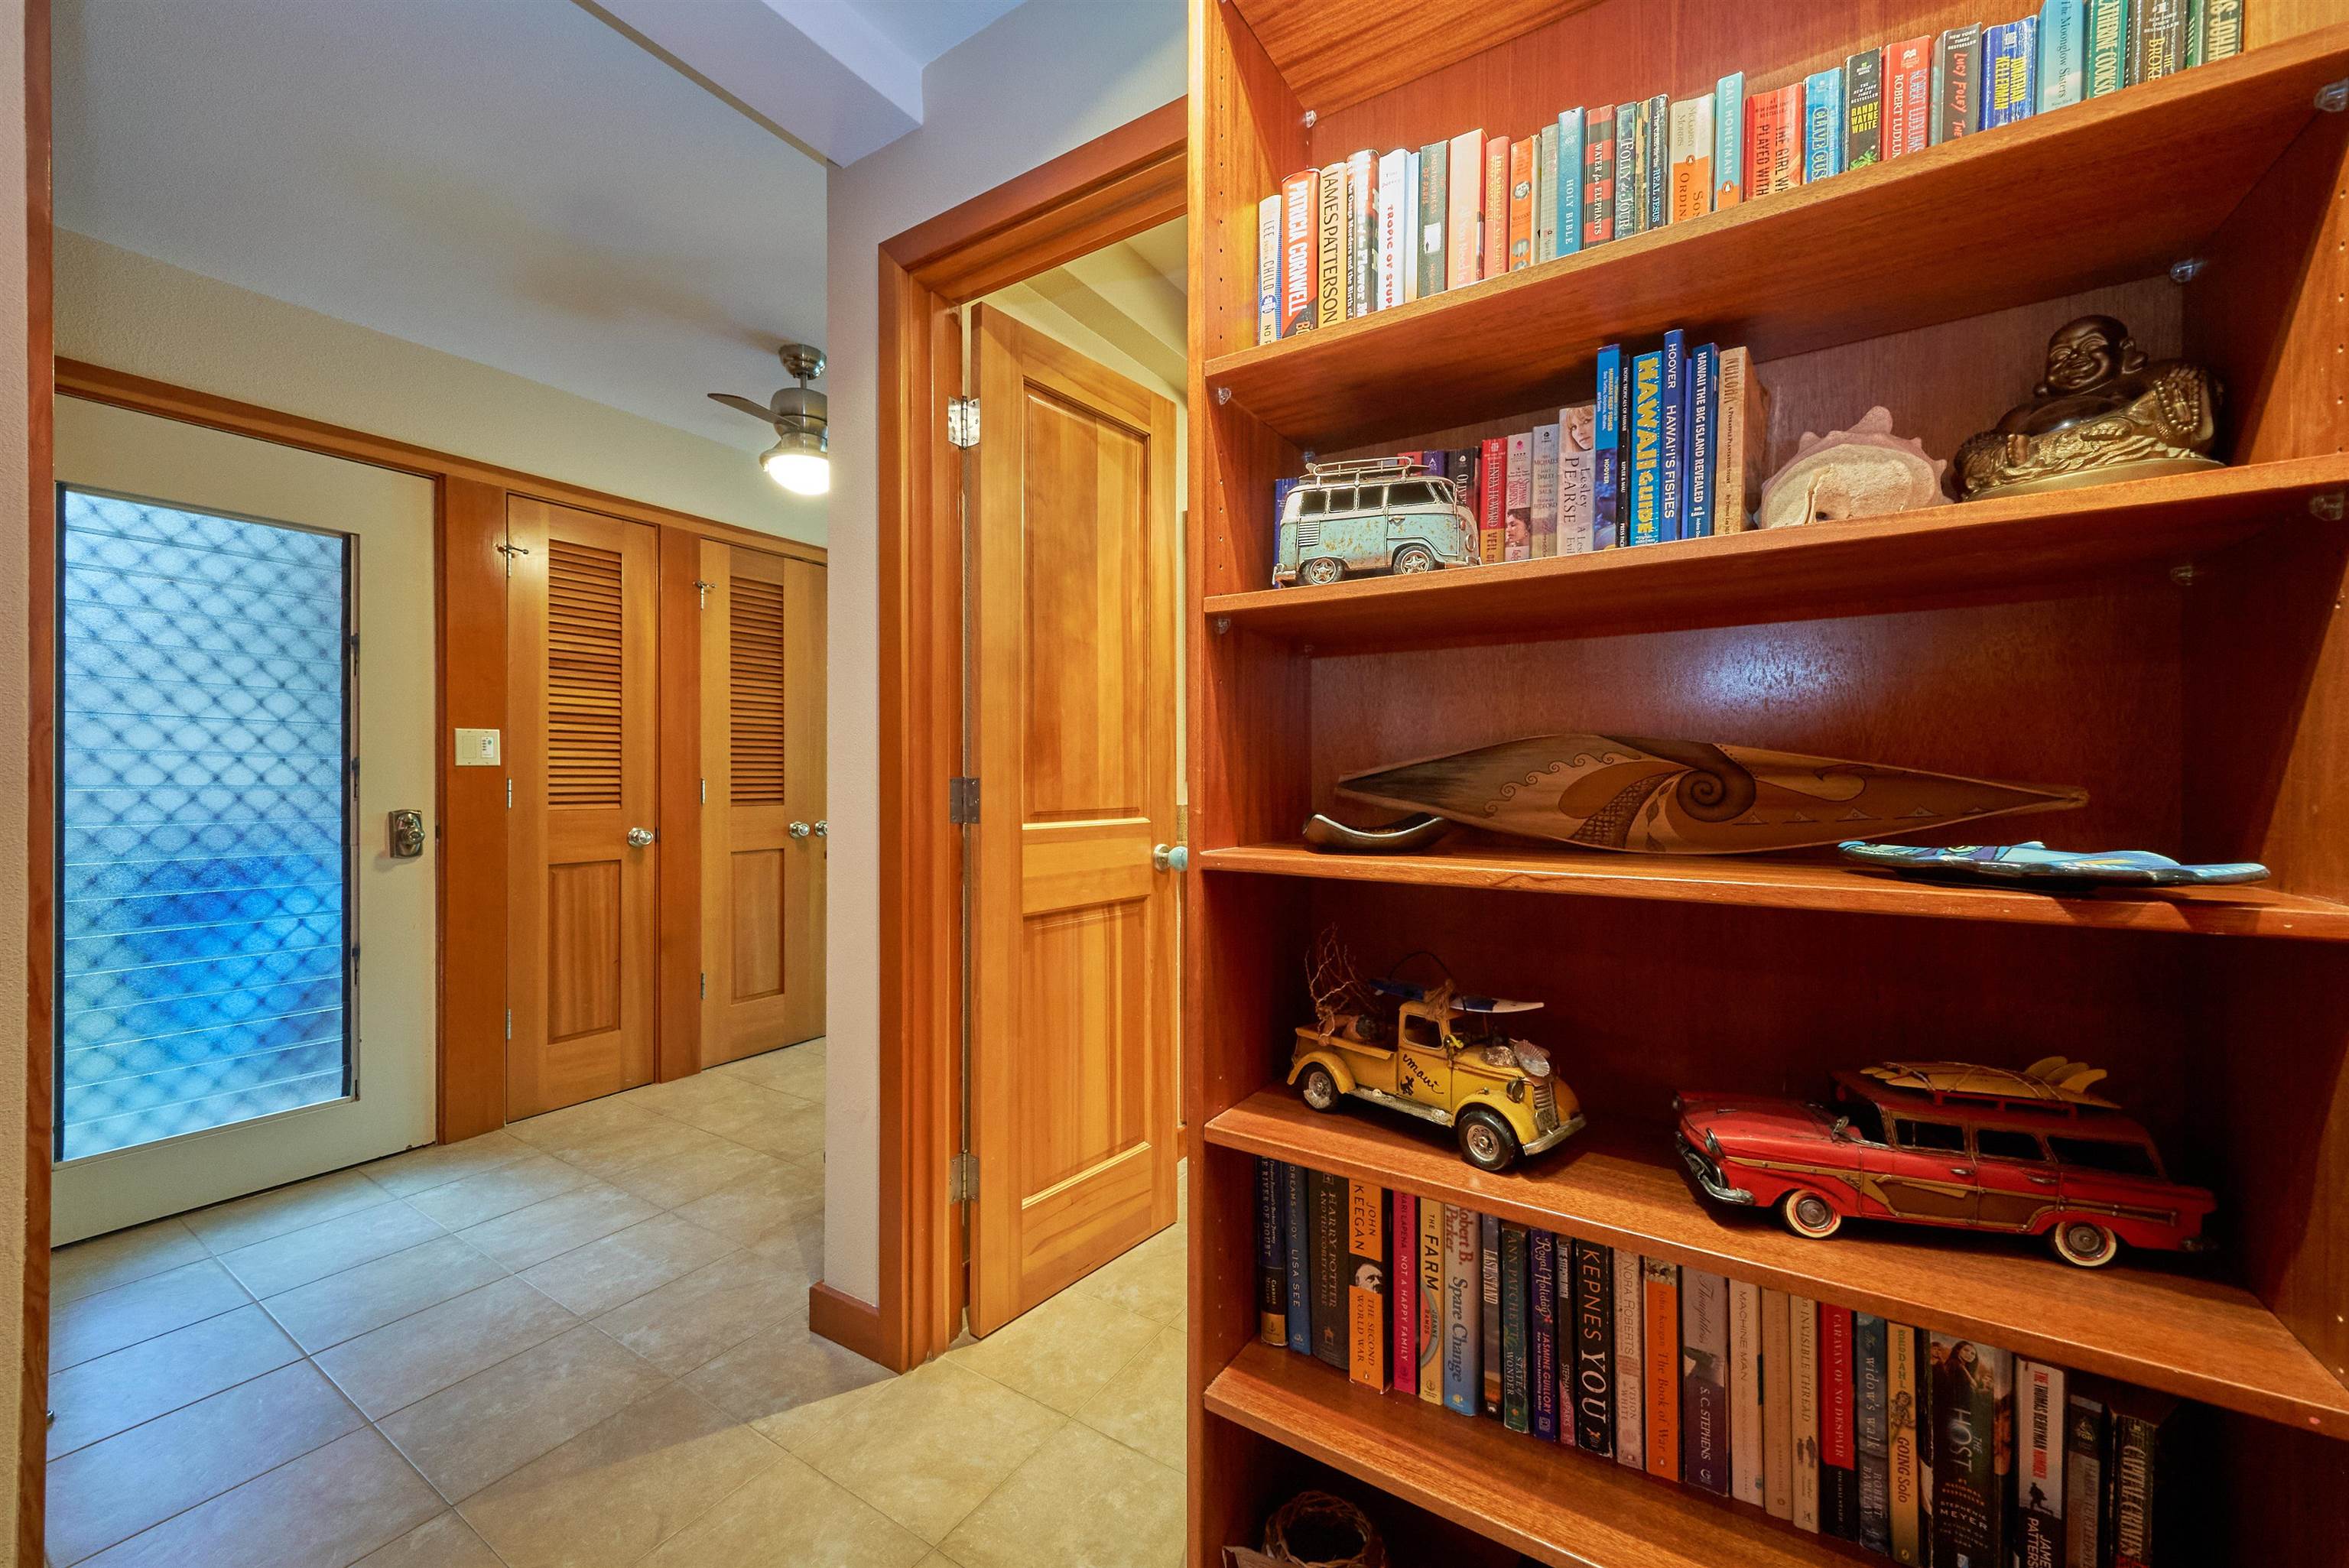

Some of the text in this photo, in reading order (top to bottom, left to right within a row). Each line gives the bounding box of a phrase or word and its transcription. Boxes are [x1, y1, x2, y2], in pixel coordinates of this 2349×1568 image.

[1948, 40, 1977, 50] BESTSELLER
[1961, 29, 1977, 37] YORK
[2057, 1, 2073, 98] The Moonglow Sisters
[1994, 56, 2010, 110] KELLERMAN
[2010, 56, 2027, 104] JONATHAN
[2163, 54, 2172, 67] THE
[1850, 92, 1879, 104] BESTSELLER
[1851, 101, 1879, 115] RANDY
[1851, 111, 1879, 125] WAYNE
[1893, 74, 1904, 115] ROBERT
[1951, 53, 1968, 138] LUCY FOLEY THE
[1724, 80, 1734, 174] GAIL HONEYMAN
[1776, 125, 1789, 175] THE GIRL
[1813, 108, 1829, 149] CLIVE
[1851, 120, 1878, 134] WHITE
[1619, 139, 1634, 227] FOLLY JOUR
[1652, 168, 1660, 195] REAL
[1756, 124, 1770, 196] PLAYED WITH
[1346, 195, 1354, 219] Osage
[1565, 179, 1574, 245] HOLY BIBLE
[1591, 143, 1603, 235] WATER for ELEPHANTS
[1264, 219, 1275, 237] LEE
[1288, 180, 1308, 317] PATRICIA CORNWELL
[1322, 172, 1339, 323] JAMES PATTERSON
[1386, 204, 1394, 268] TROPIC OF
[1263, 261, 1275, 291] CHILD
[1358, 249, 1368, 300] Flower
[1457, 243, 1470, 268] Need
[1347, 308, 1354, 317] of
[1636, 357, 1659, 471] HAWAII
[1664, 343, 1677, 518] HOOVER FISHES
[1694, 352, 1707, 503] HAWAII THE BIG ISLAND REVEALED
[1487, 461, 1499, 488] LINDA
[1563, 456, 1580, 524] PEARSE
[1576, 468, 1590, 507] Lesley
[1487, 489, 1499, 528] HOWARD
[1636, 471, 1655, 534] GUIDE
[1486, 532, 1498, 550] VEIL
[1402, 1055, 1444, 1095] maui
[1262, 1170, 1271, 1257] RIVER OF DOUBT
[1353, 1184, 1364, 1251] KEEGAN
[1367, 1203, 1376, 1236] JOHN
[1444, 1206, 1458, 1254] Parker
[1291, 1248, 1300, 1277] LISA
[1327, 1191, 1338, 1308] HARRY POTTER
[1425, 1234, 1439, 1291] FARM
[1458, 1251, 1473, 1265] B.
[1560, 1246, 1568, 1258] THE
[1292, 1283, 1301, 1308] SEE
[1483, 1248, 1498, 1304] LAST STAND
[1508, 1235, 1519, 1341] ANN PATCHETT
[1535, 1237, 1552, 1317] Royal Holiday
[1448, 1276, 1468, 1383] Spare Change
[1623, 1260, 1635, 1355] NORA ROBERTS
[1581, 1248, 1607, 1424] KEPNES YOU
[1506, 1351, 1515, 1395] WONDER
[1515, 1356, 1523, 1388] STATE
[1542, 1332, 1551, 1414] JASMINE GUILLORY
[1656, 1290, 1668, 1451] John Keegan The Book of War
[1740, 1352, 1748, 1381] MAN
[1801, 1310, 1811, 1423] INVISIBLE THREAD
[1833, 1313, 1844, 1457] CARAVAN OF NO DESPAIR
[1865, 1356, 1881, 1451] widow's walk
[2034, 1371, 2048, 1413] THE THOMAS
[1700, 1397, 1711, 1460] C. STEPHENS
[1951, 1407, 1972, 1472] HOST
[1973, 1437, 1983, 1454] THE
[1873, 1472, 1883, 1518] ROBERT
[1897, 1437, 1910, 1503] GOING Solo
[1940, 1508, 1988, 1531] MEYER
